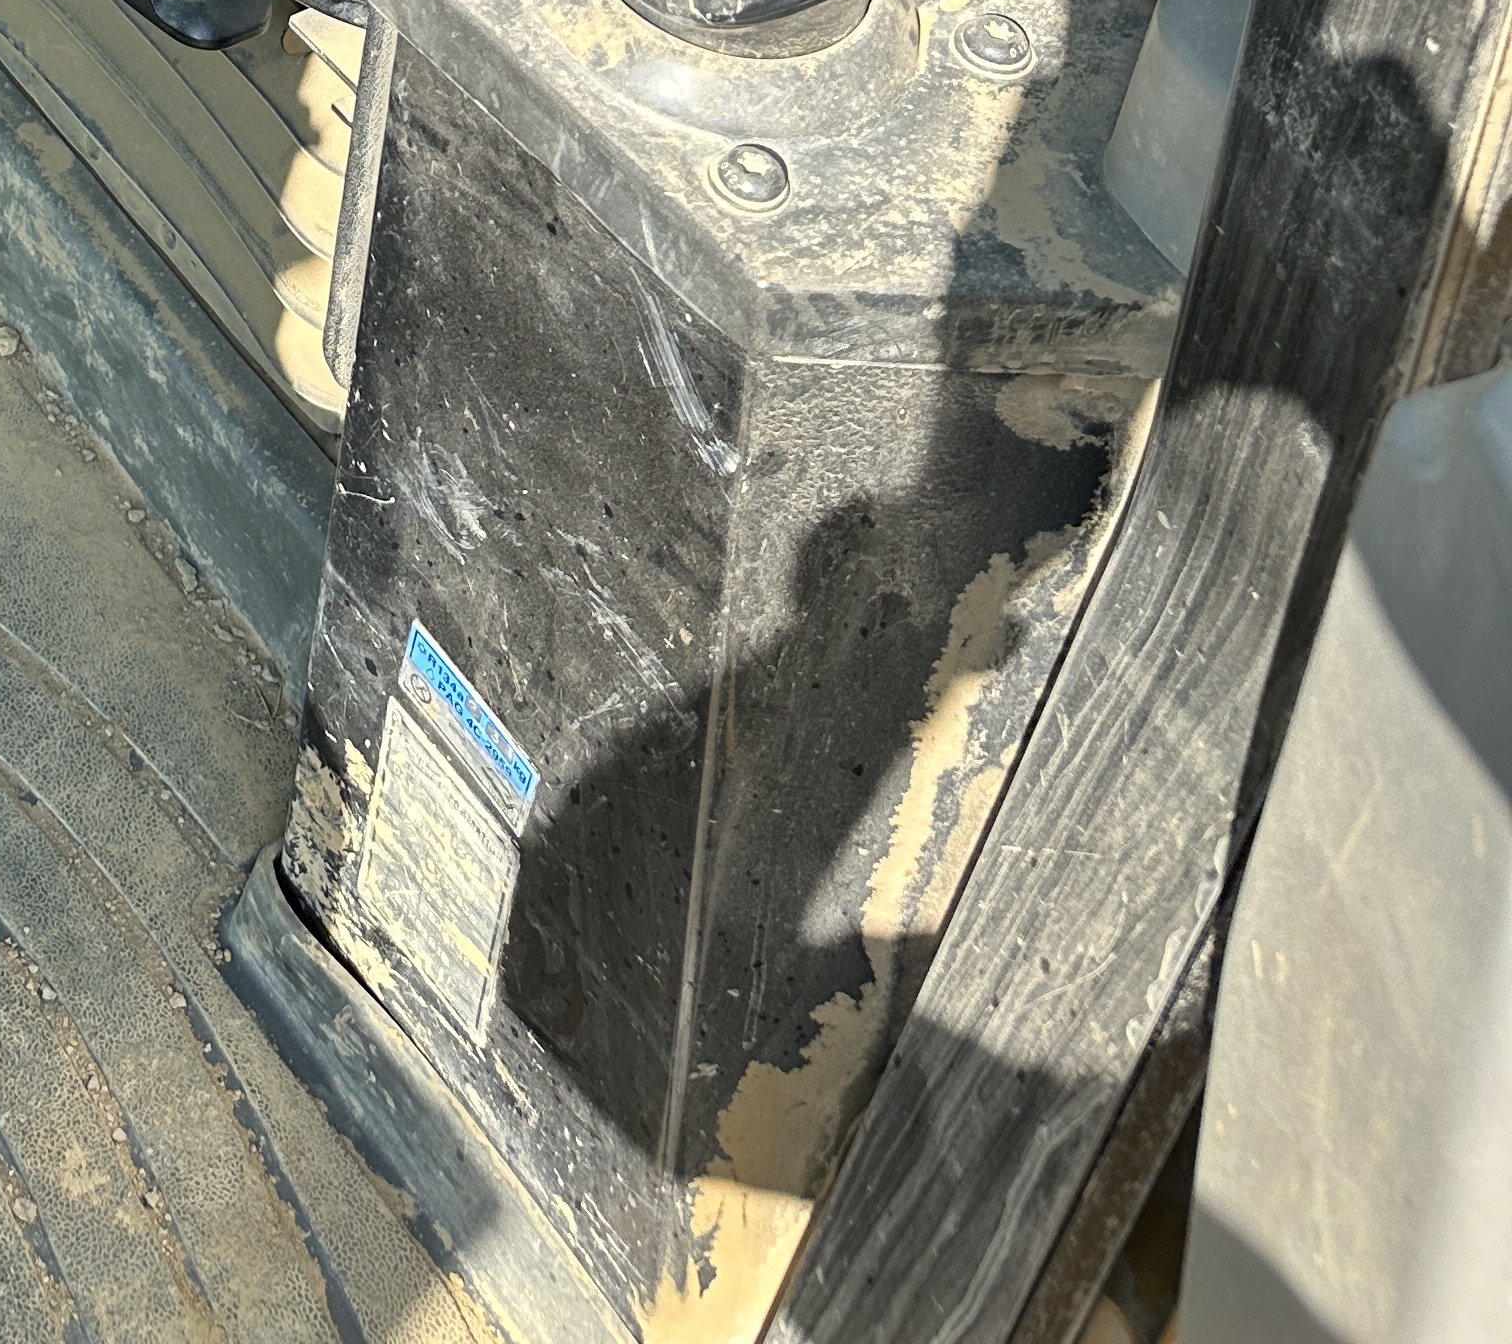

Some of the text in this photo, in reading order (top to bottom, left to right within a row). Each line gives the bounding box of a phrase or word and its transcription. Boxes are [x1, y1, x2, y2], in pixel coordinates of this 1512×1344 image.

[426, 653, 465, 703] R134a
[512, 760, 527, 785] kg
[437, 680, 464, 717] PAG
